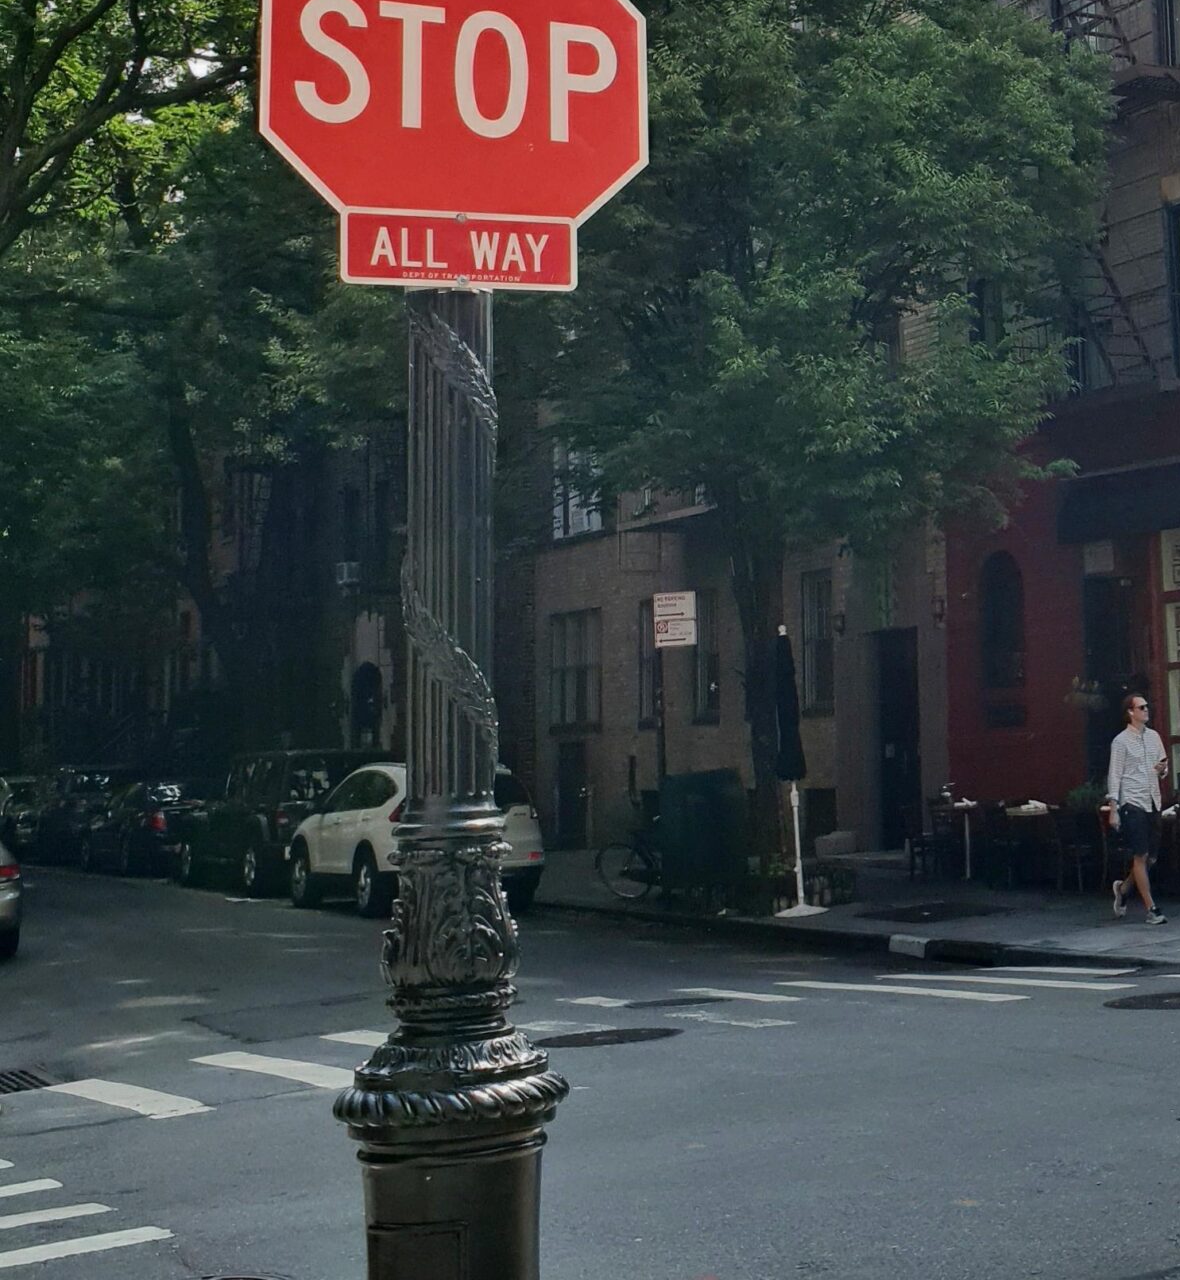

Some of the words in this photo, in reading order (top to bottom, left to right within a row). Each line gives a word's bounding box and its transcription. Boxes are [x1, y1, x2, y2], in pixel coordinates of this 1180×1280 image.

[370, 226, 448, 269] ALL
[470, 231, 549, 273] WAY
[402, 271, 425, 279] DEPT
